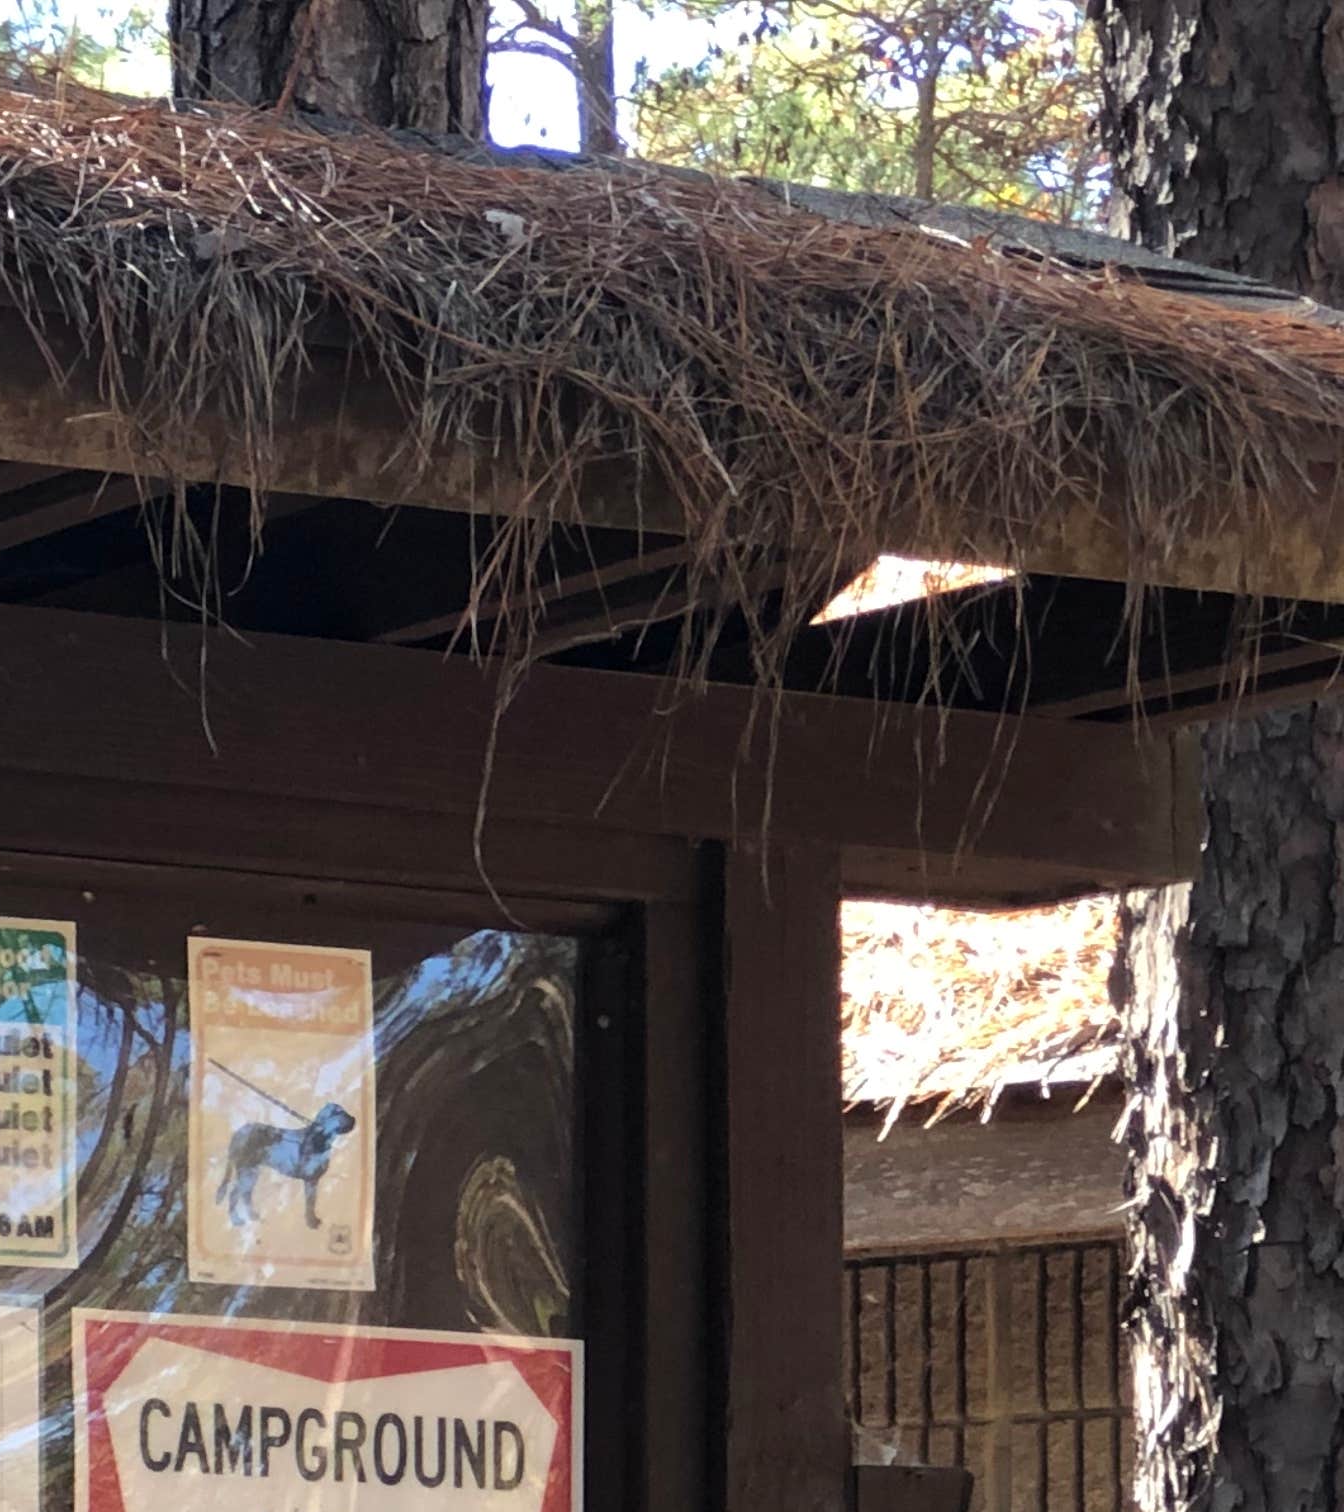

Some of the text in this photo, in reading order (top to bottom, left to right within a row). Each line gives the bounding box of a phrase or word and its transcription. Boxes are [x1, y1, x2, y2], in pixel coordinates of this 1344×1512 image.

[202, 957, 334, 988] Pets Must
[16, 1214, 55, 1238] AM
[140, 1398, 525, 1491] CAMPGROUND
